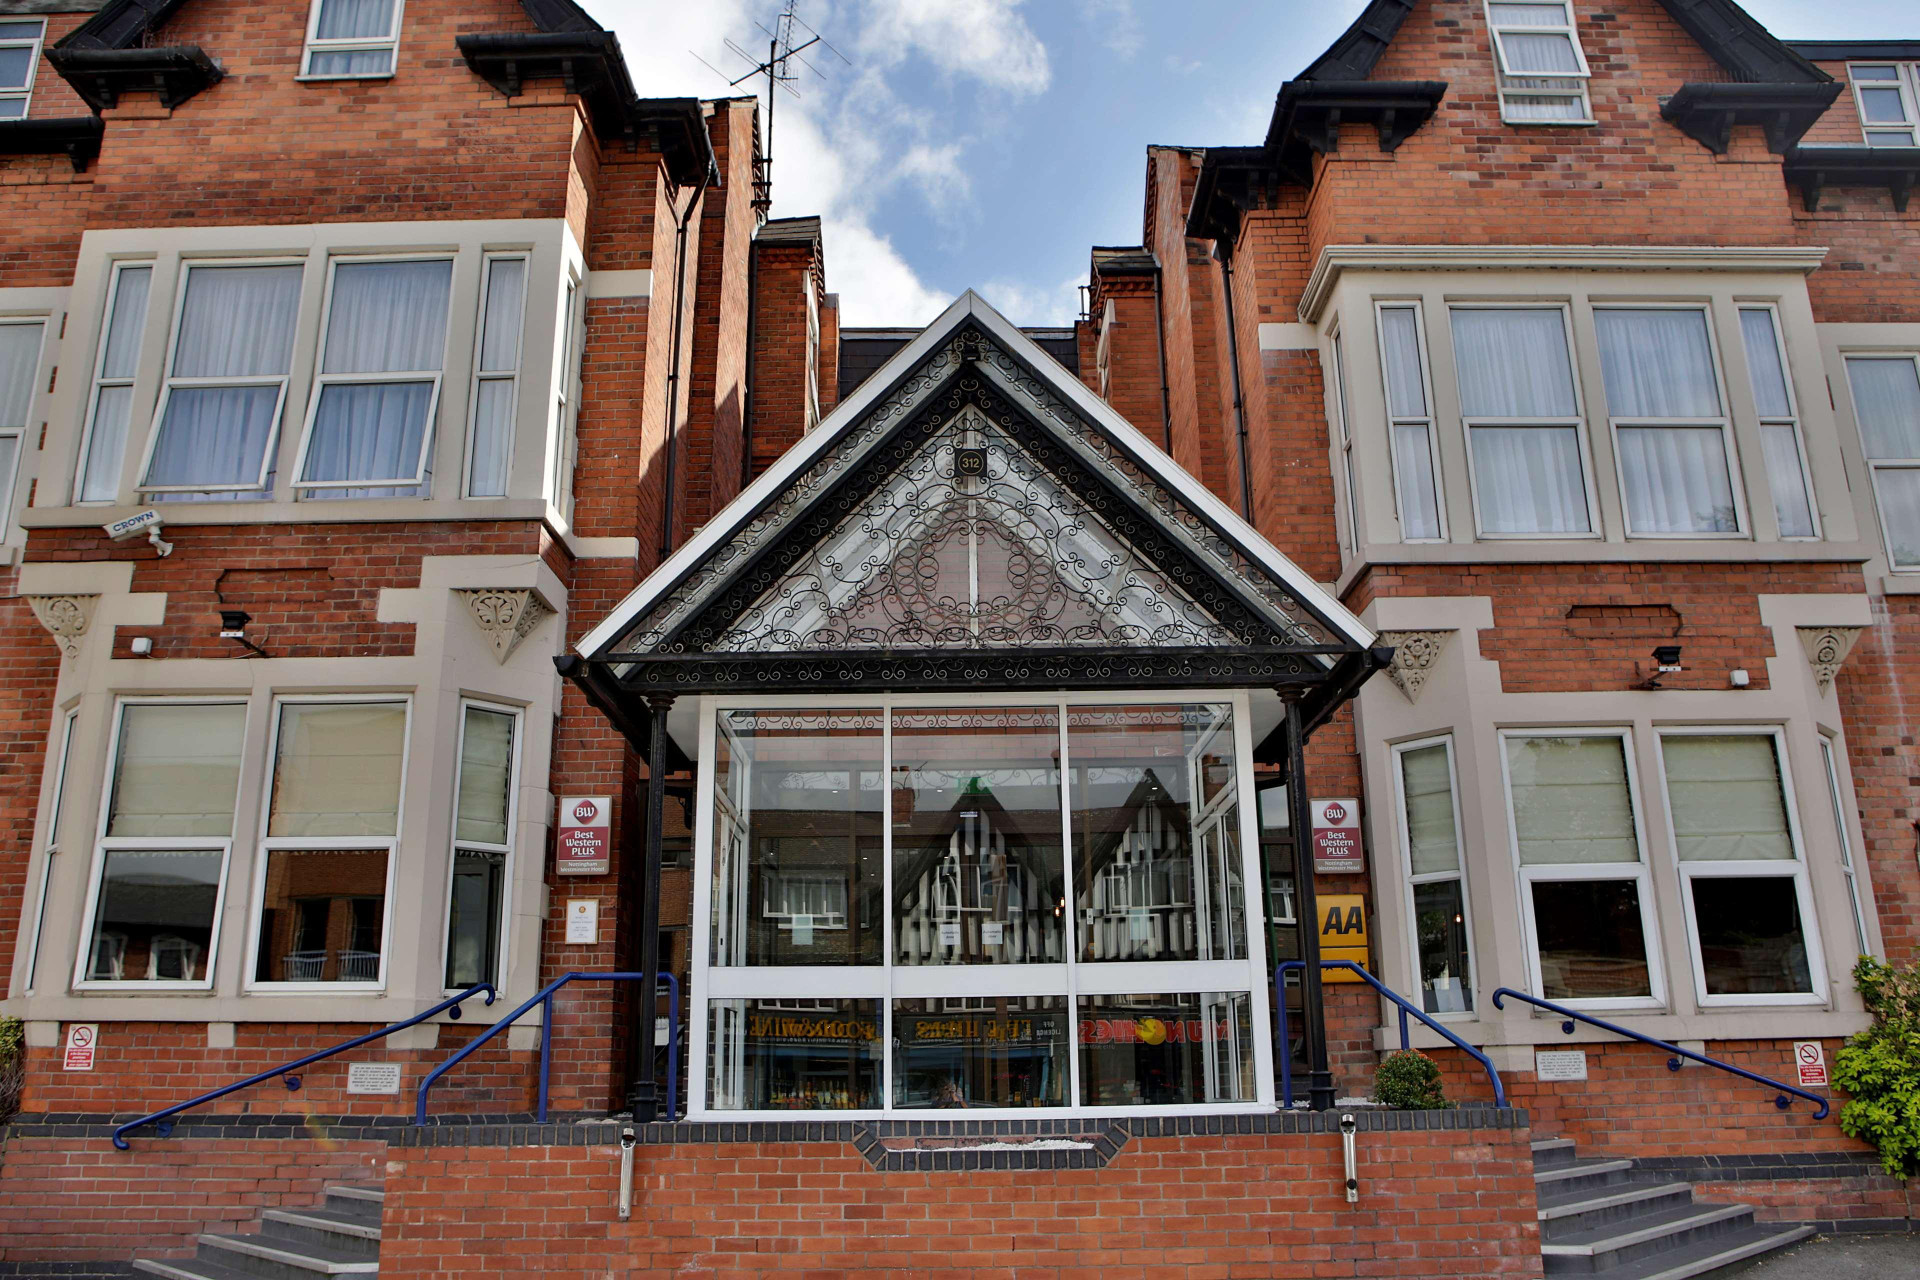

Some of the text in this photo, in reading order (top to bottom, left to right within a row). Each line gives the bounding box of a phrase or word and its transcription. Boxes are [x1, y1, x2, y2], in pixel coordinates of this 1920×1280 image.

[962, 457, 980, 468] 312
[112, 511, 154, 532] CROWN
[576, 807, 595, 817] BW
[1326, 808, 1344, 819] BW
[574, 830, 594, 839] Best
[1327, 831, 1346, 839] Best
[565, 838, 602, 847] Western
[1319, 839, 1354, 847] Western
[571, 847, 595, 856] PLUS
[1326, 847, 1349, 855] PLUS
[1322, 906, 1363, 935] AA
